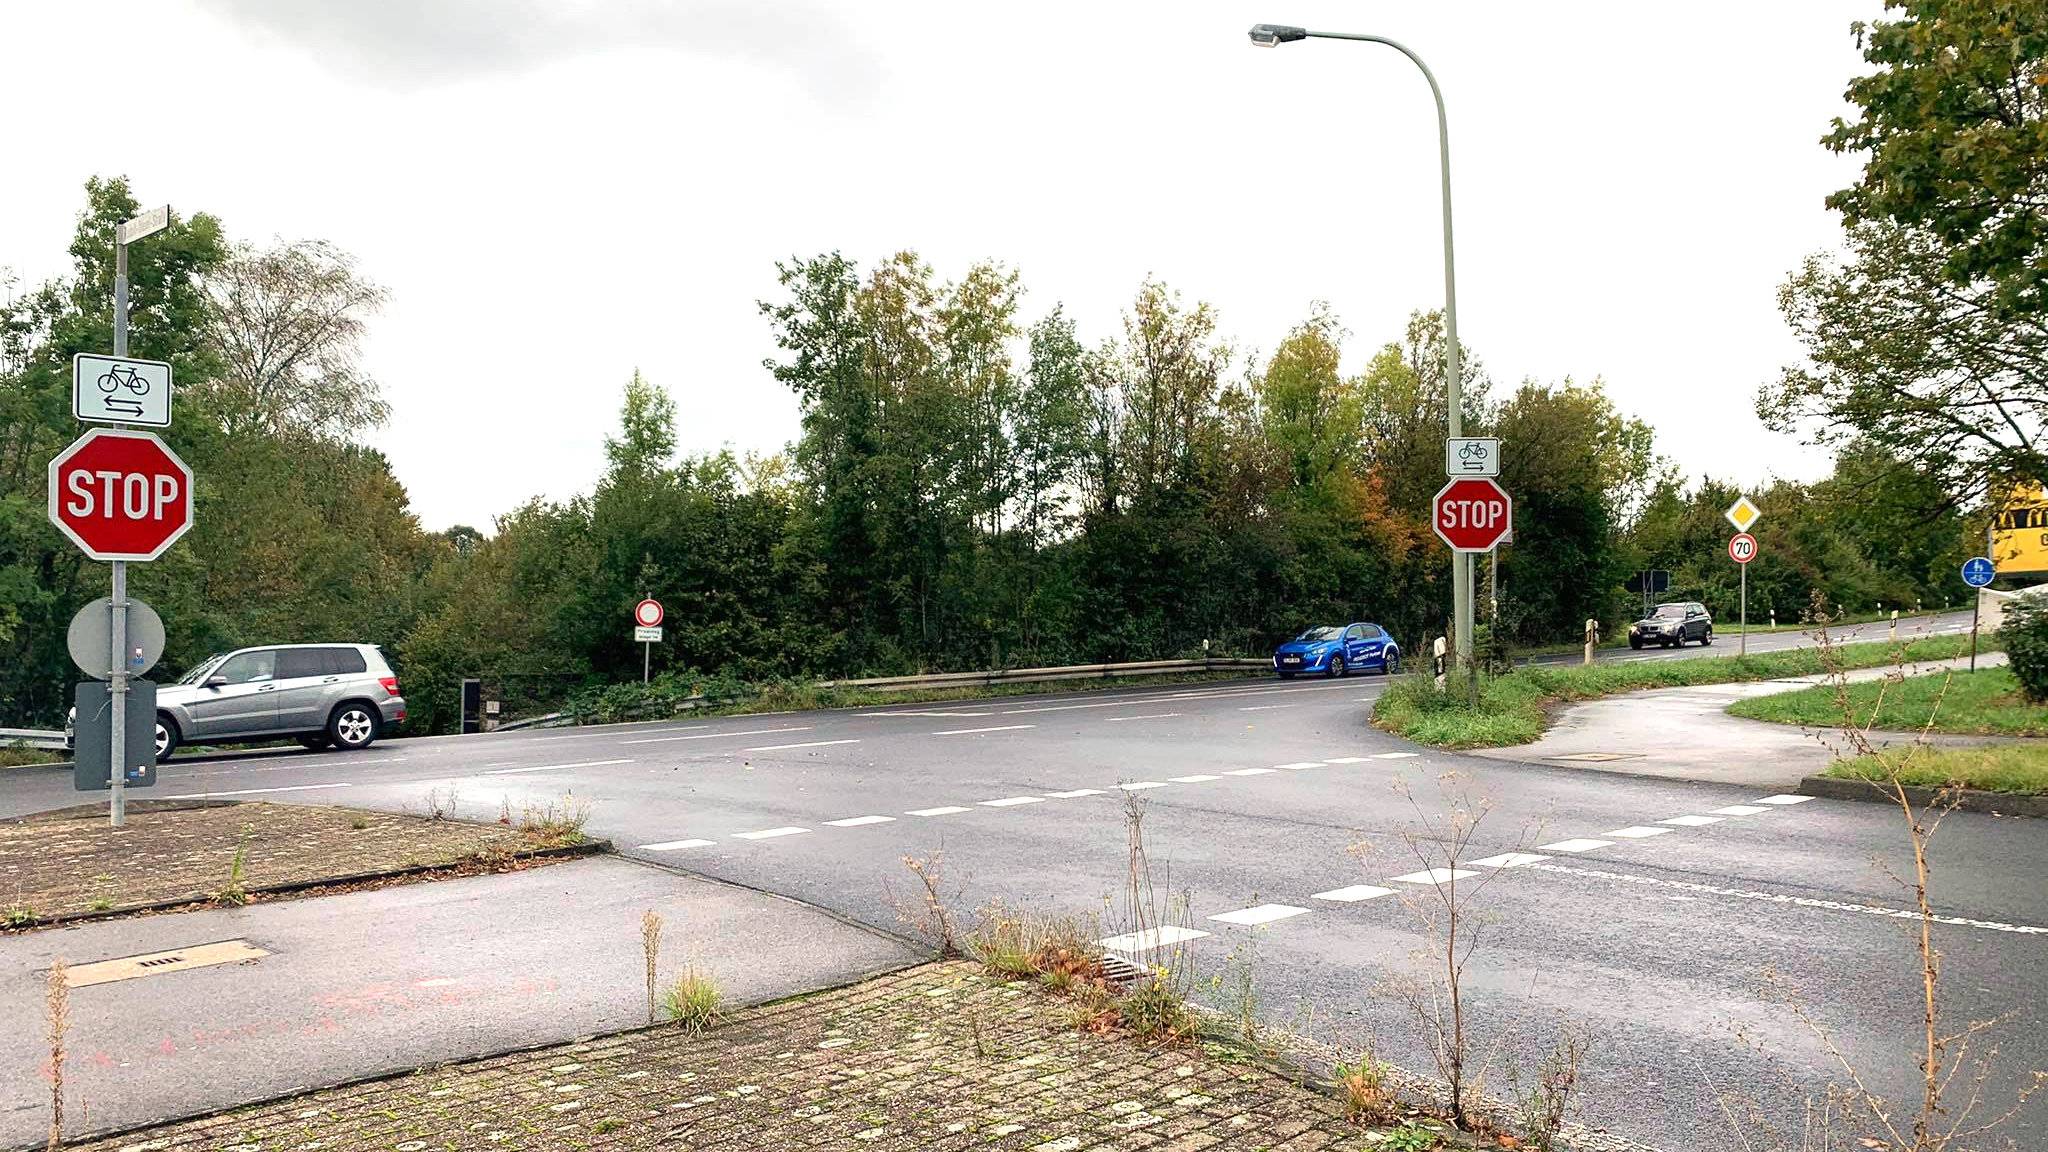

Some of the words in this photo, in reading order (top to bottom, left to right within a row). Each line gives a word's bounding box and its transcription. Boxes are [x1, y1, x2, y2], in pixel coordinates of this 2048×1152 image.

[67, 469, 178, 520] STOP
[1442, 500, 1503, 529] STOP
[1736, 542, 1750, 554] 70
